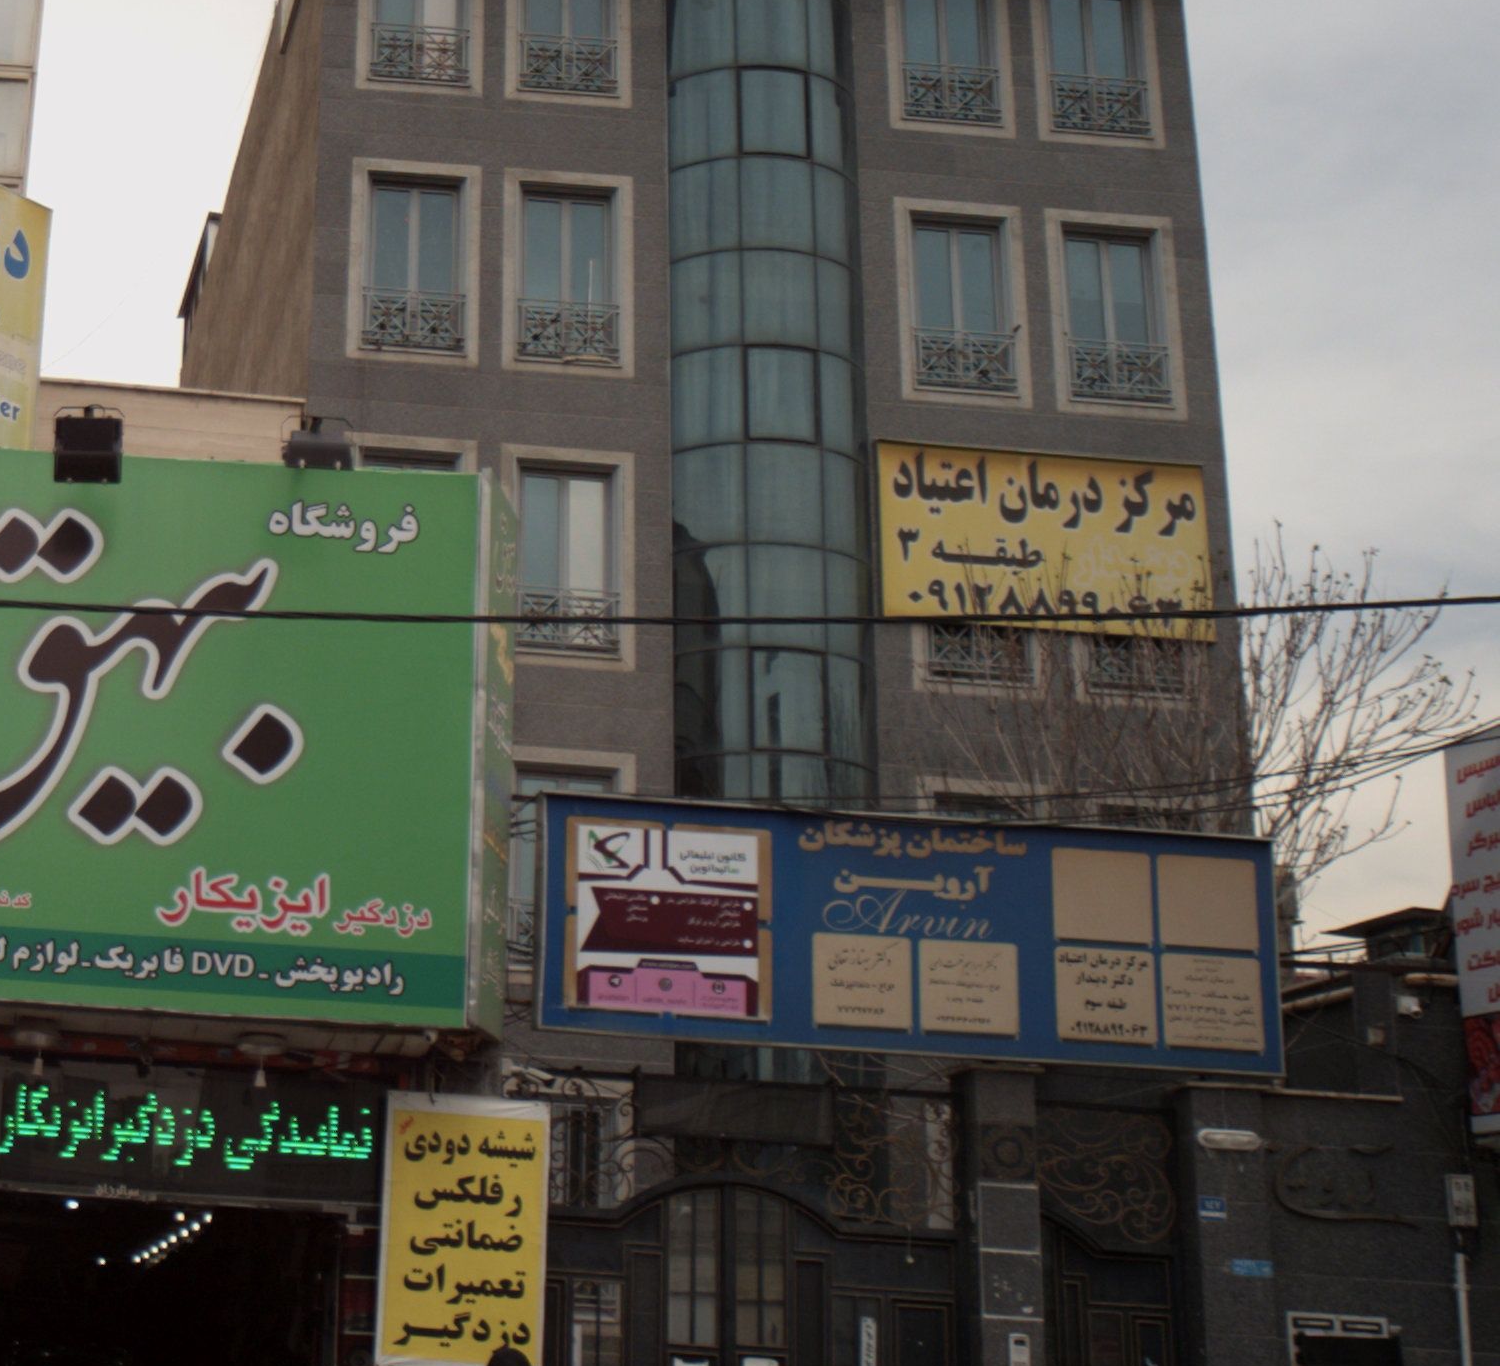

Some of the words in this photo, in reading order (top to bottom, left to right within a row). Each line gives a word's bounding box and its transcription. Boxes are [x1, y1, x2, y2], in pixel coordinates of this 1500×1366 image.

[893, 451, 988, 514] اعتیاد
[1000, 461, 1103, 529] درمان
[1115, 470, 1196, 537] مرکز
[267, 502, 421, 554] فروشگاه
[898, 526, 920, 561] ۳
[932, 538, 1045, 576] طبقه
[798, 821, 904, 859] پزشکان
[905, 827, 1028, 858] ساختمان
[11, 892, 33, 908] کد
[156, 865, 331, 935] ایزیکار
[833, 865, 996, 910] آروین
[334, 898, 432, 937] دزدگیر
[822, 888, 994, 939] Arvin
[12, 939, 80, 974] لوازم
[94, 944, 185, 980] فابریک
[191, 950, 256, 979] DVD
[274, 957, 405, 996] رادیوپخش
[100, 1092, 216, 1168] دزدگیر
[404, 1130, 471, 1165] دودی
[478, 1130, 536, 1168] شیشه
[413, 1174, 522, 1218] رفلکس
[410, 1218, 523, 1256] ضمانتی
[403, 1263, 526, 1305] تعمیرات
[392, 1311, 531, 1349] دزدگیر
